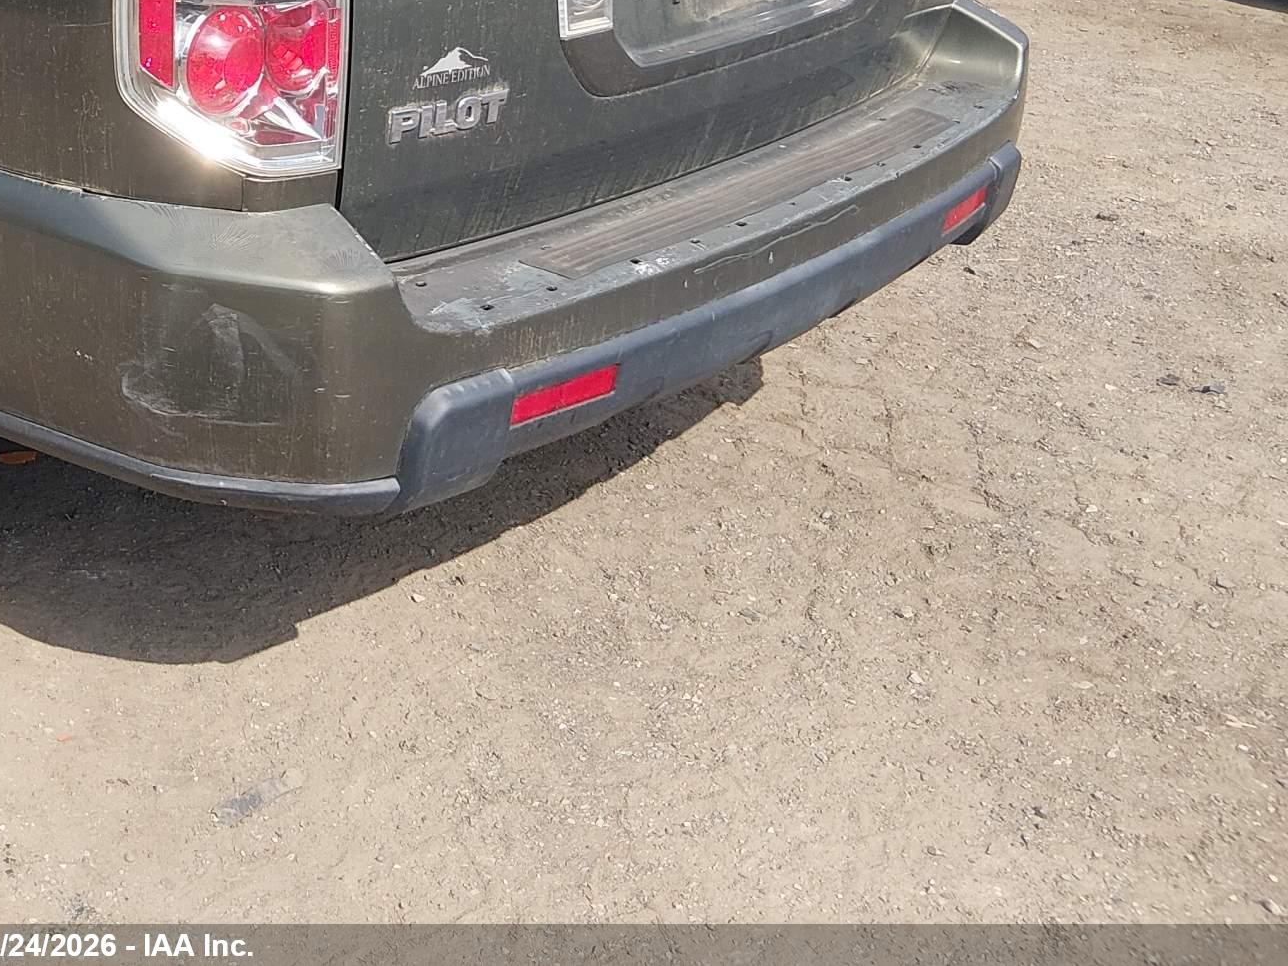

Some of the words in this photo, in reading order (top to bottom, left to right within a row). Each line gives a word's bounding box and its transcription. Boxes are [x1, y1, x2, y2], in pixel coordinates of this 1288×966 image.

[412, 73, 449, 90] ALPINE
[451, 64, 491, 83] EDITION
[388, 89, 510, 144] PILOT
